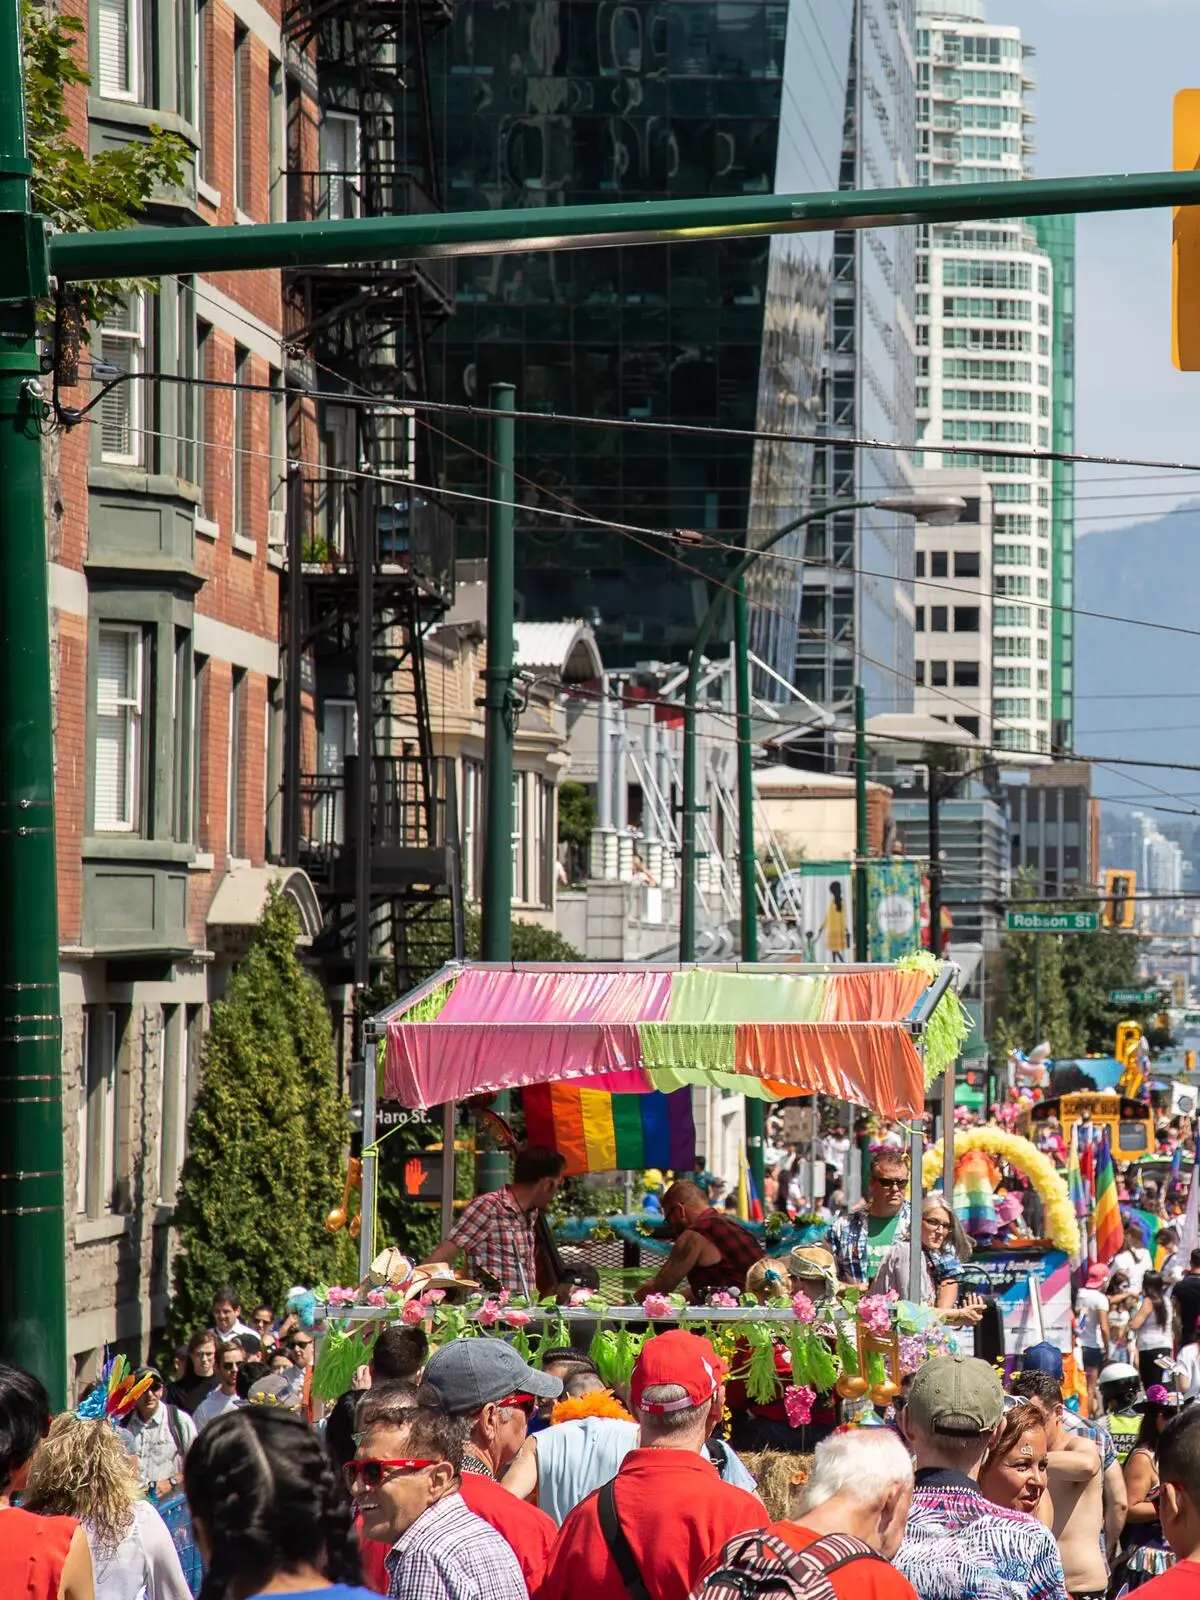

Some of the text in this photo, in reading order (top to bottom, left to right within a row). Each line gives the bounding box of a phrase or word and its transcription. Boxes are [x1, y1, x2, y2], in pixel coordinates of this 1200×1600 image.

[1013, 914, 1091, 928] Robson St
[375, 1109, 433, 1124] Haro St.
